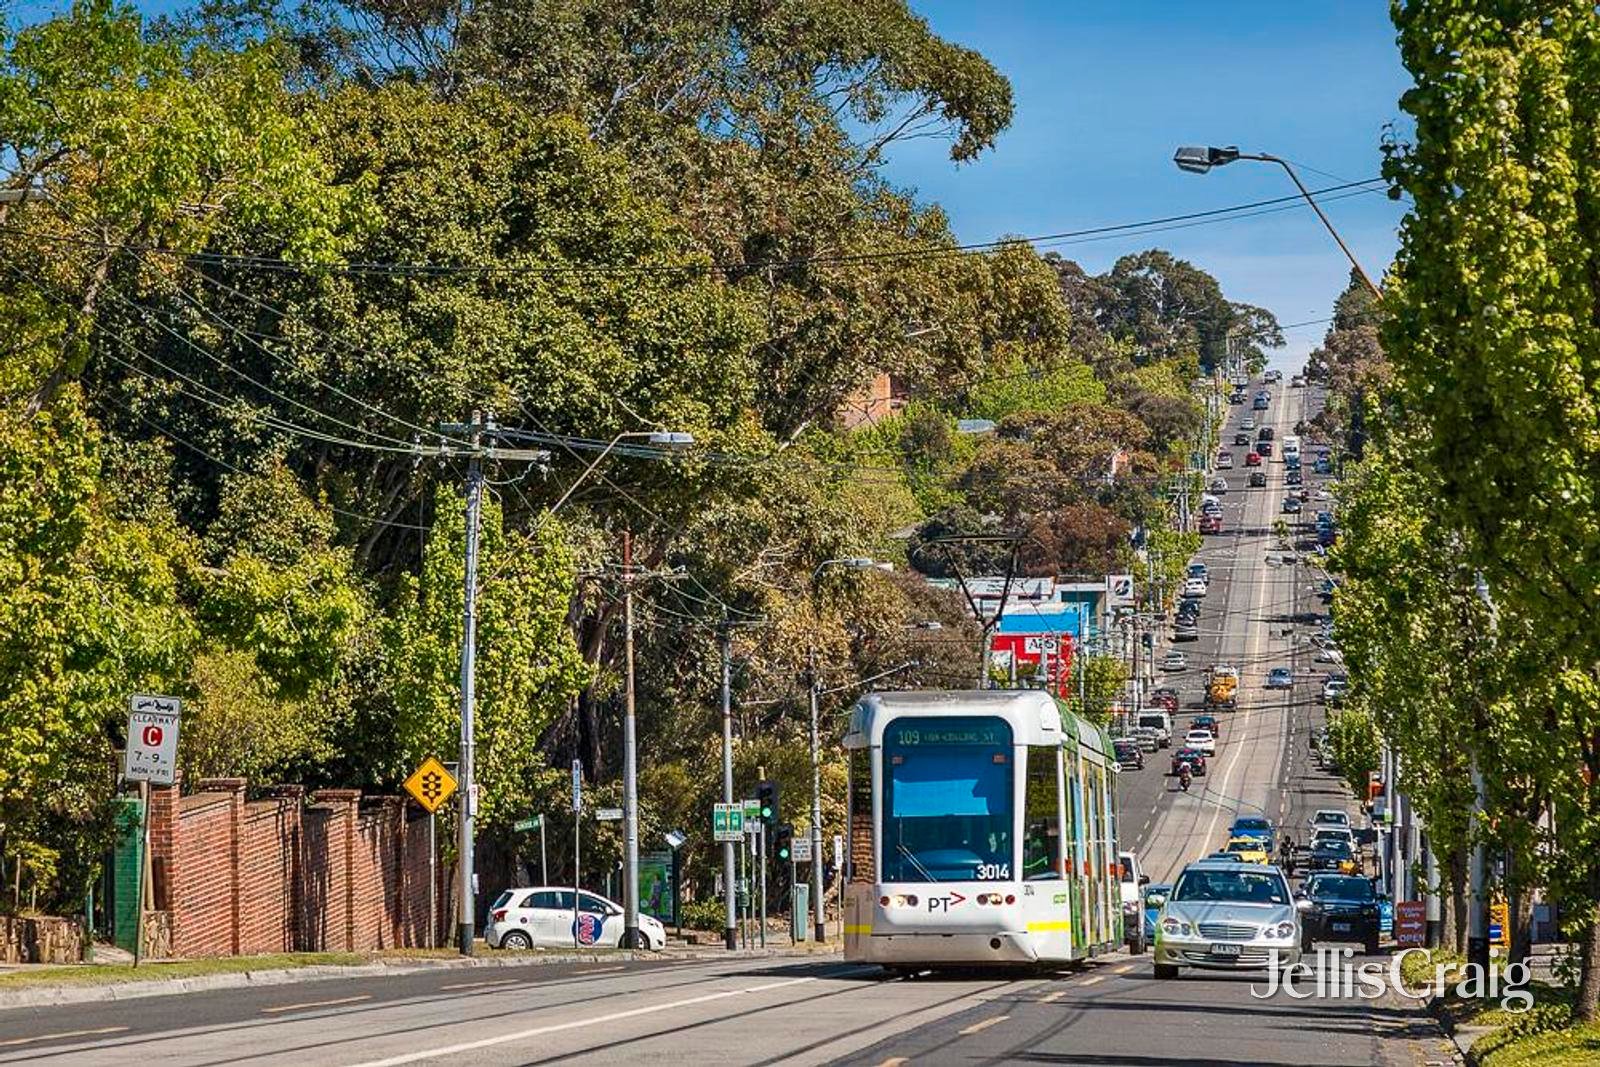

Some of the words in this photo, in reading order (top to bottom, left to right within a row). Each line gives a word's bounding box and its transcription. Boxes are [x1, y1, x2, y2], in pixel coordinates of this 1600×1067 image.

[133, 714, 177, 725] CLEARWAY
[148, 728, 159, 746] C
[898, 730, 920, 745] 109
[976, 863, 1010, 880] 3014
